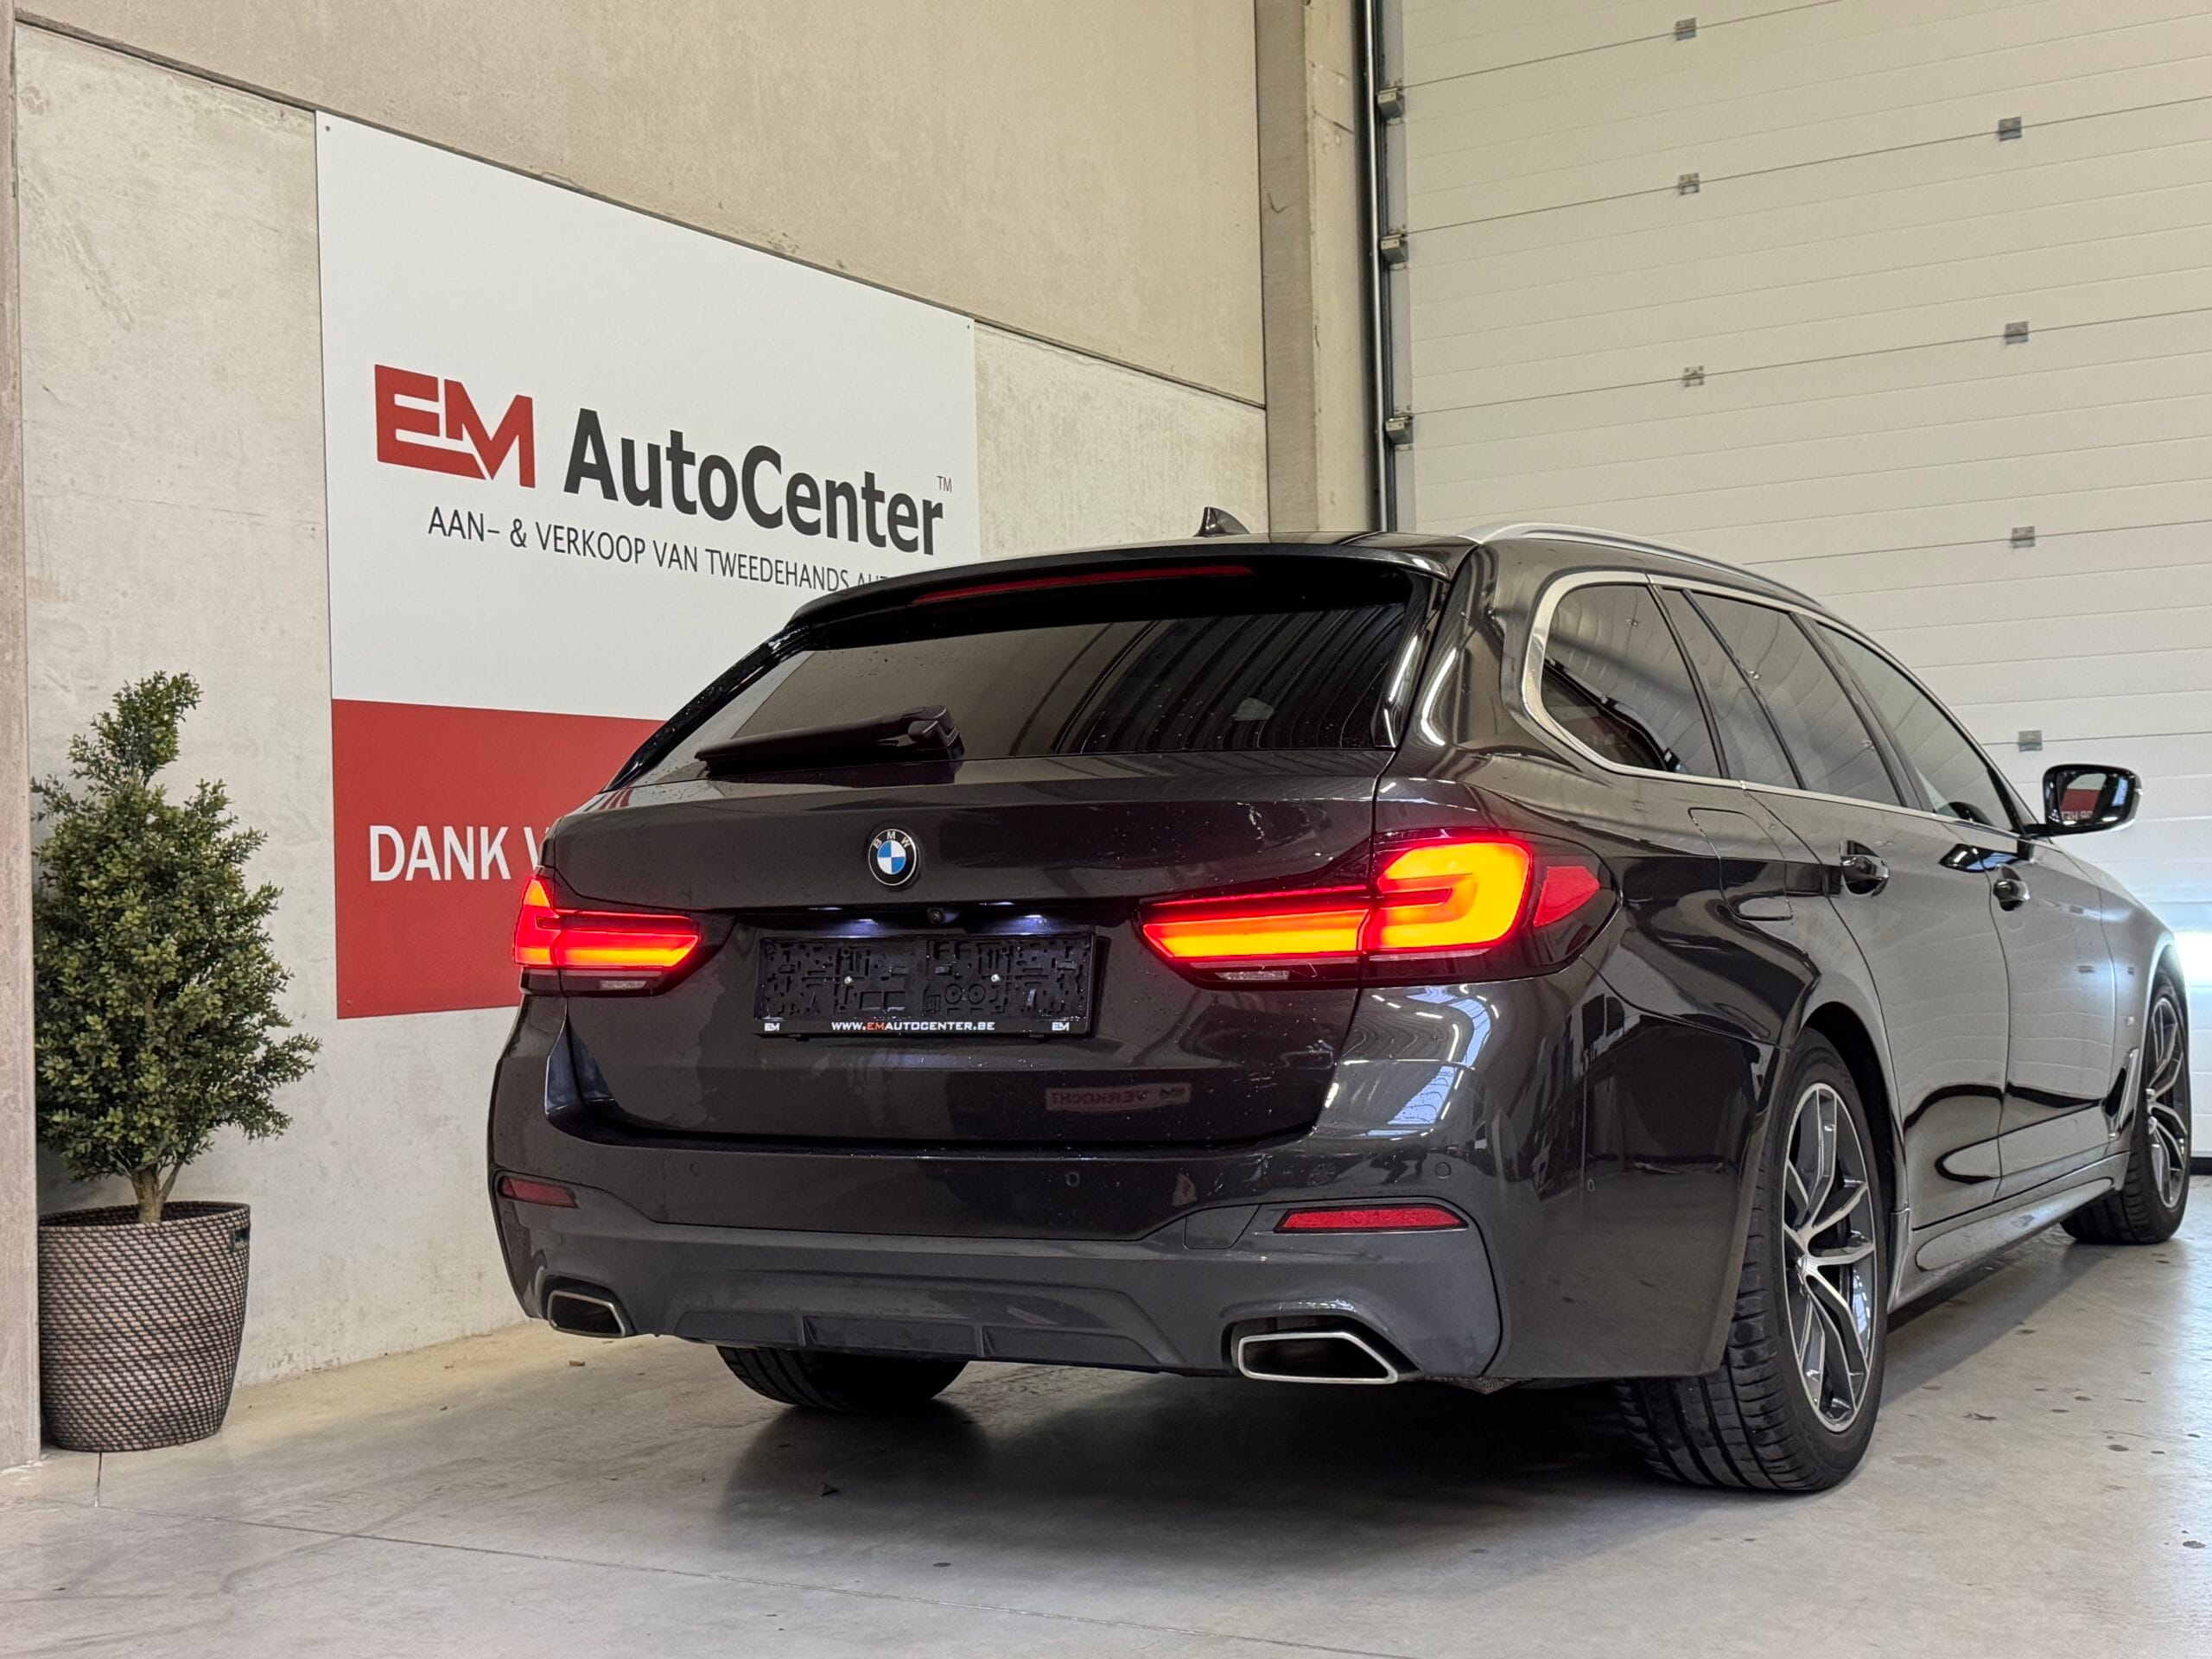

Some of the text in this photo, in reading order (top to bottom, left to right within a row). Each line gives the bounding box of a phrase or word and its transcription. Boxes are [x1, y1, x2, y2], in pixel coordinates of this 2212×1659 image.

[374, 364, 536, 489] EM
[563, 407, 944, 556] AutoCenter
[510, 518, 527, 549] &
[535, 521, 646, 564] VERKOOP
[652, 539, 699, 573] VAN
[704, 548, 850, 592] TWEEDEHANDS
[369, 824, 512, 881] DANK
[873, 830, 912, 849] BMW
[830, 1021, 996, 1032] WWW.EMAUTOCENTER.BE
